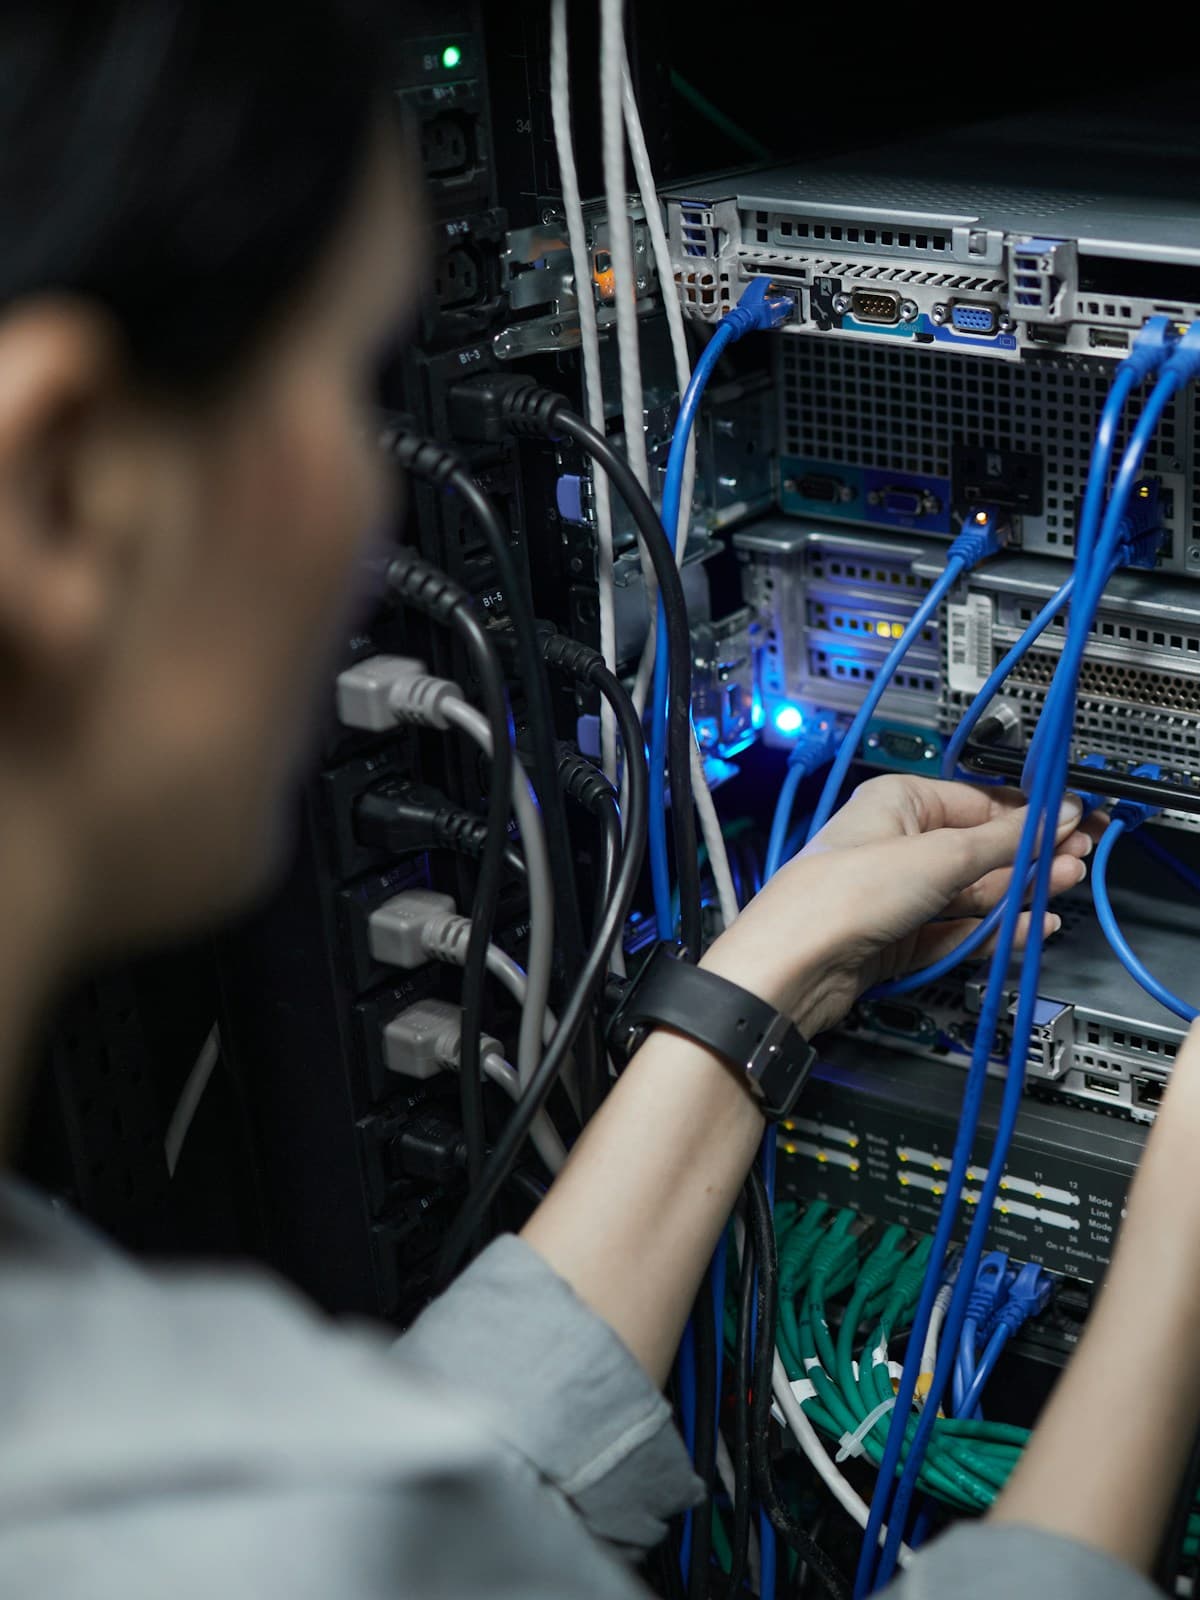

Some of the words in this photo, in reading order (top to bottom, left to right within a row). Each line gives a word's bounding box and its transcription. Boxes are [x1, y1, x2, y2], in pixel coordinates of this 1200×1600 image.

[515, 119, 533, 134] 34
[446, 220, 471, 236] B1-2
[1040, 257, 1050, 271] 2
[458, 349, 481, 366] B1-3
[482, 591, 504, 609] B1-5
[1043, 1029, 1051, 1040] 2
[1034, 1171, 1044, 1180] 11
[1068, 1180, 1078, 1190] 12
[1088, 1194, 1113, 1208] Mode
[1090, 1207, 1111, 1220] Link
[1088, 1218, 1113, 1233] Mode
[1090, 1231, 1111, 1244] Link
[1045, 1241, 1058, 1250] On
[1064, 1263, 1079, 1274] 12X
